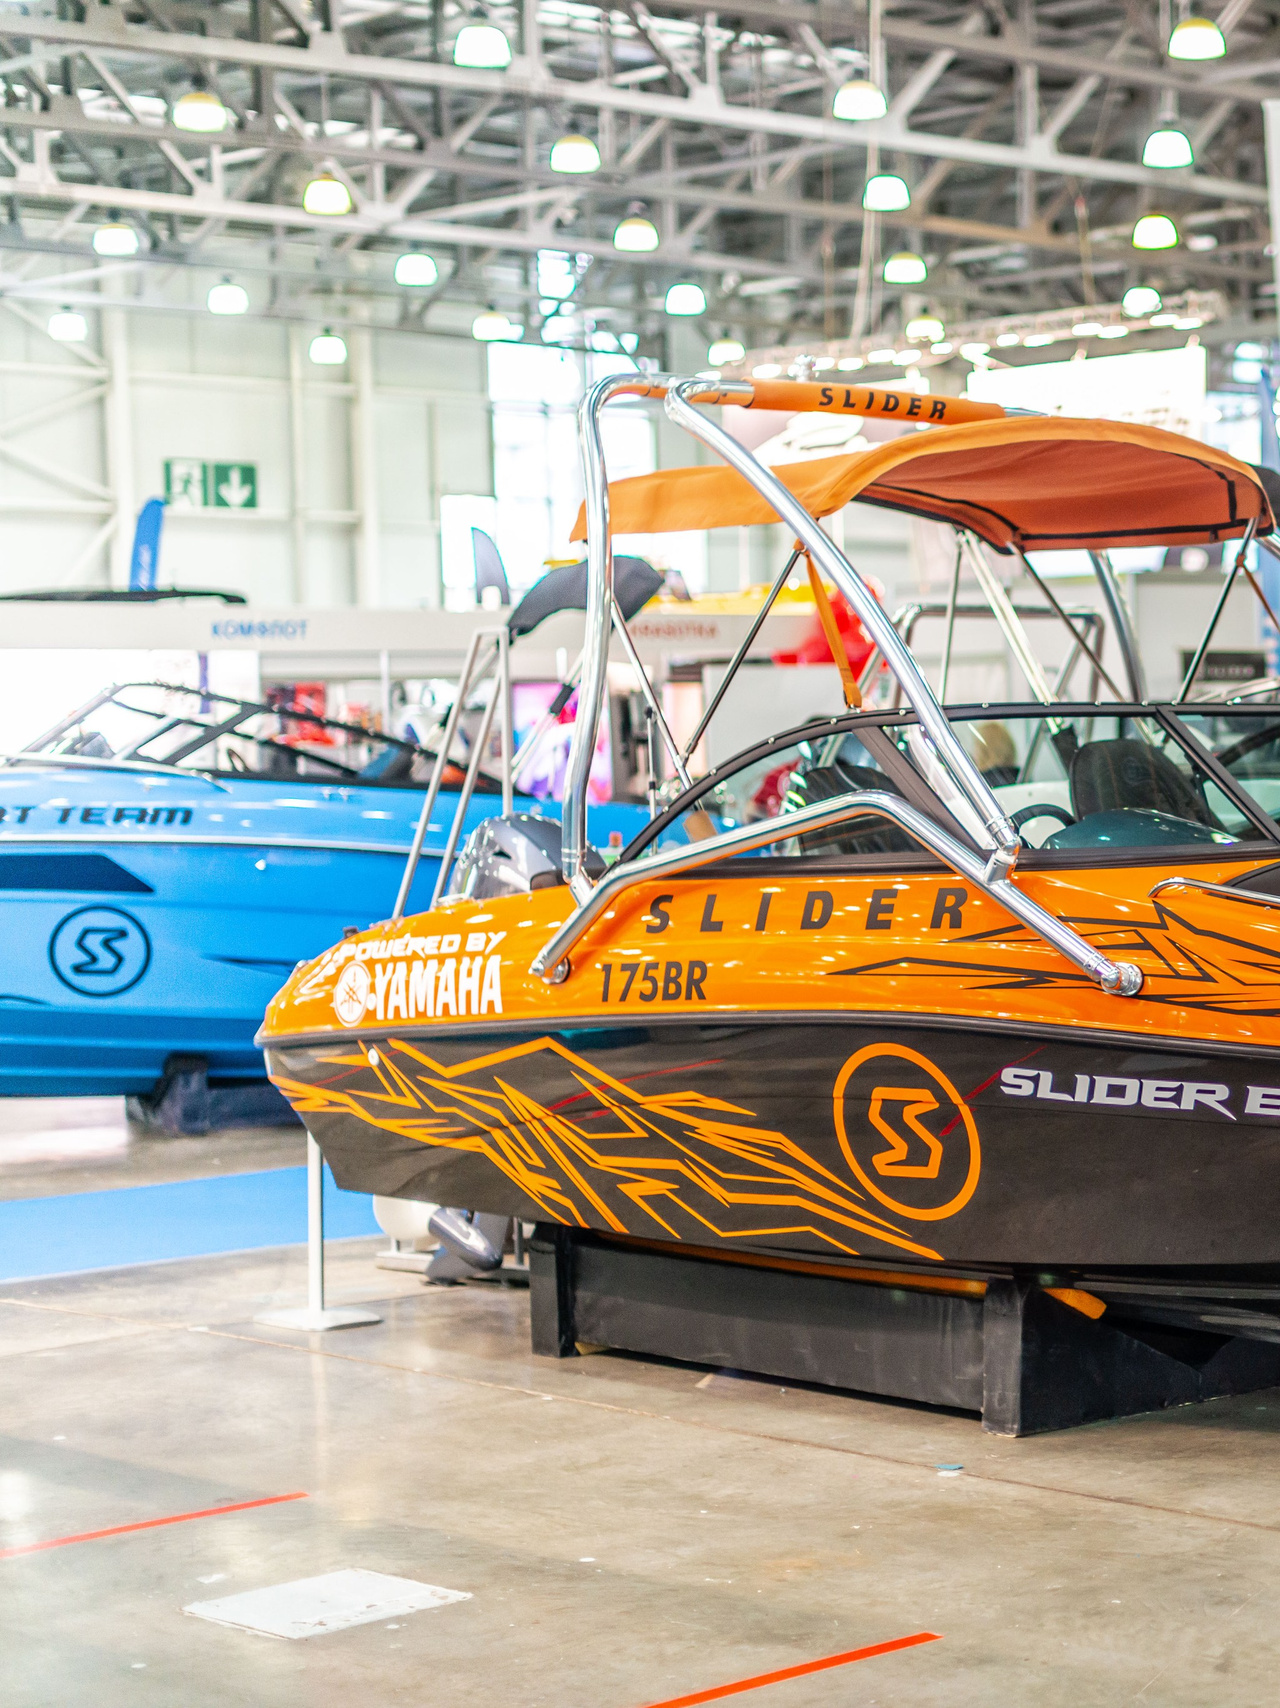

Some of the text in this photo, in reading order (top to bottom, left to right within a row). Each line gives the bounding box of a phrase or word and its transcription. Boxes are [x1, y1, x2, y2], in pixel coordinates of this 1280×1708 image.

[818, 387, 947, 421] SLIDER
[53, 805, 193, 826] TEAM
[645, 886, 969, 934] SLIDER
[337, 931, 508, 959] POWERED BY
[374, 954, 503, 1021] YAMAHA
[601, 960, 708, 1003] 175BR
[1000, 1066, 1237, 1121] SLIDER
